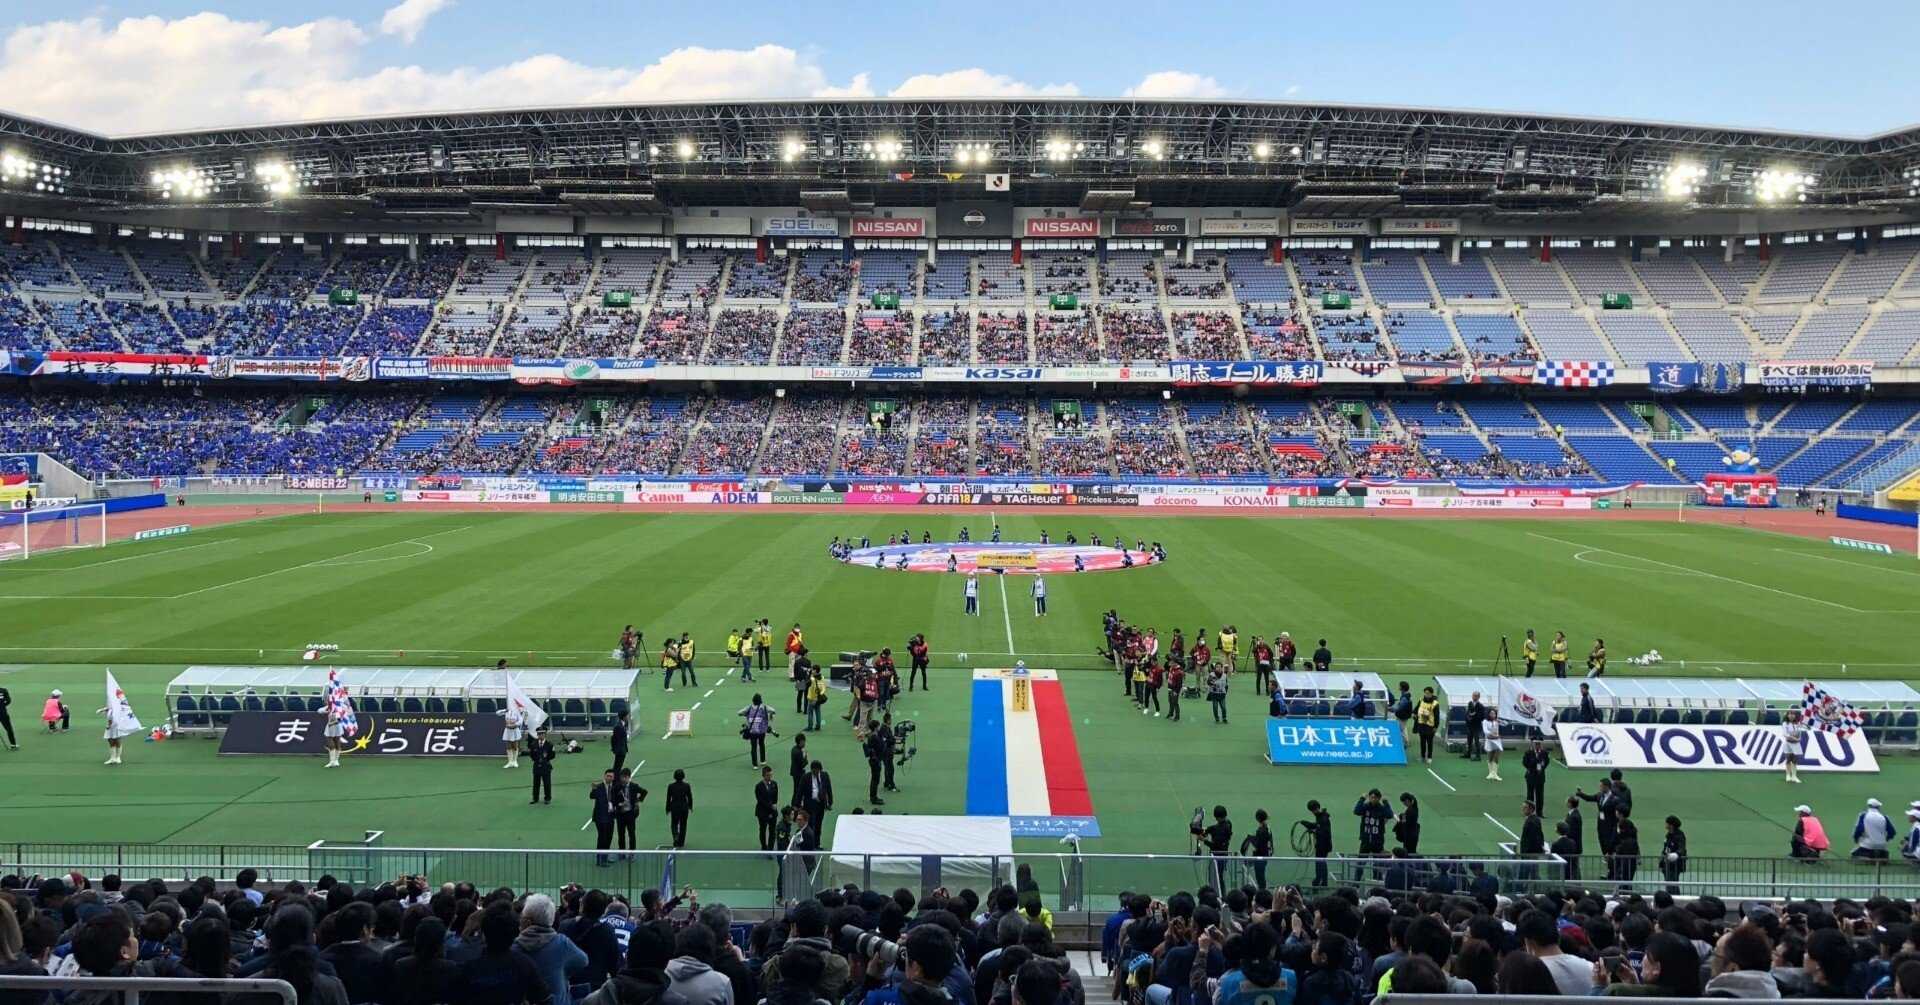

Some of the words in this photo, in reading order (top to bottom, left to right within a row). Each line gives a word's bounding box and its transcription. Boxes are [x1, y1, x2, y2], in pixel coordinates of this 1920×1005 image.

[770, 219, 814, 229] SOEI
[857, 222, 919, 233] NISSAN
[1031, 222, 1093, 233] NISSAN
[341, 289, 353, 297] E26
[613, 292, 625, 300] E25
[1328, 294, 1340, 302] E22
[1606, 293, 1618, 301] E21
[430, 358, 452, 373] PAINT
[466, 358, 510, 373] TRICOLORE
[1761, 364, 1872, 377] すべては勝利の為に
[378, 367, 428, 377] YOKOHAMA
[1065, 369, 1086, 377] Green
[1086, 369, 1109, 377] House
[1656, 364, 1686, 388] 道
[311, 398, 325, 408] E16
[596, 399, 609, 409] E15
[873, 401, 887, 411] E14
[1058, 402, 1071, 411] E13
[1342, 403, 1355, 412] E12
[1633, 404, 1646, 413] E11
[292, 477, 335, 489] BOMBER
[335, 477, 347, 490] 22
[558, 493, 616, 502] 明治安田生命
[637, 492, 684, 502] Canon
[773, 495, 801, 503] ROUTE
[1078, 495, 1112, 504] Priceless
[1113, 496, 1138, 505] Japan
[1153, 496, 1198, 505] docomo
[1223, 496, 1278, 506] KONAMI
[1296, 496, 1356, 507] 明治安田生命
[385, 717, 466, 727] makura-laboratory
[275, 719, 466, 754] まらぼ
[1278, 725, 1394, 747] 日本工学院
[1300, 749, 1374, 759] www.neec.ac.jp
